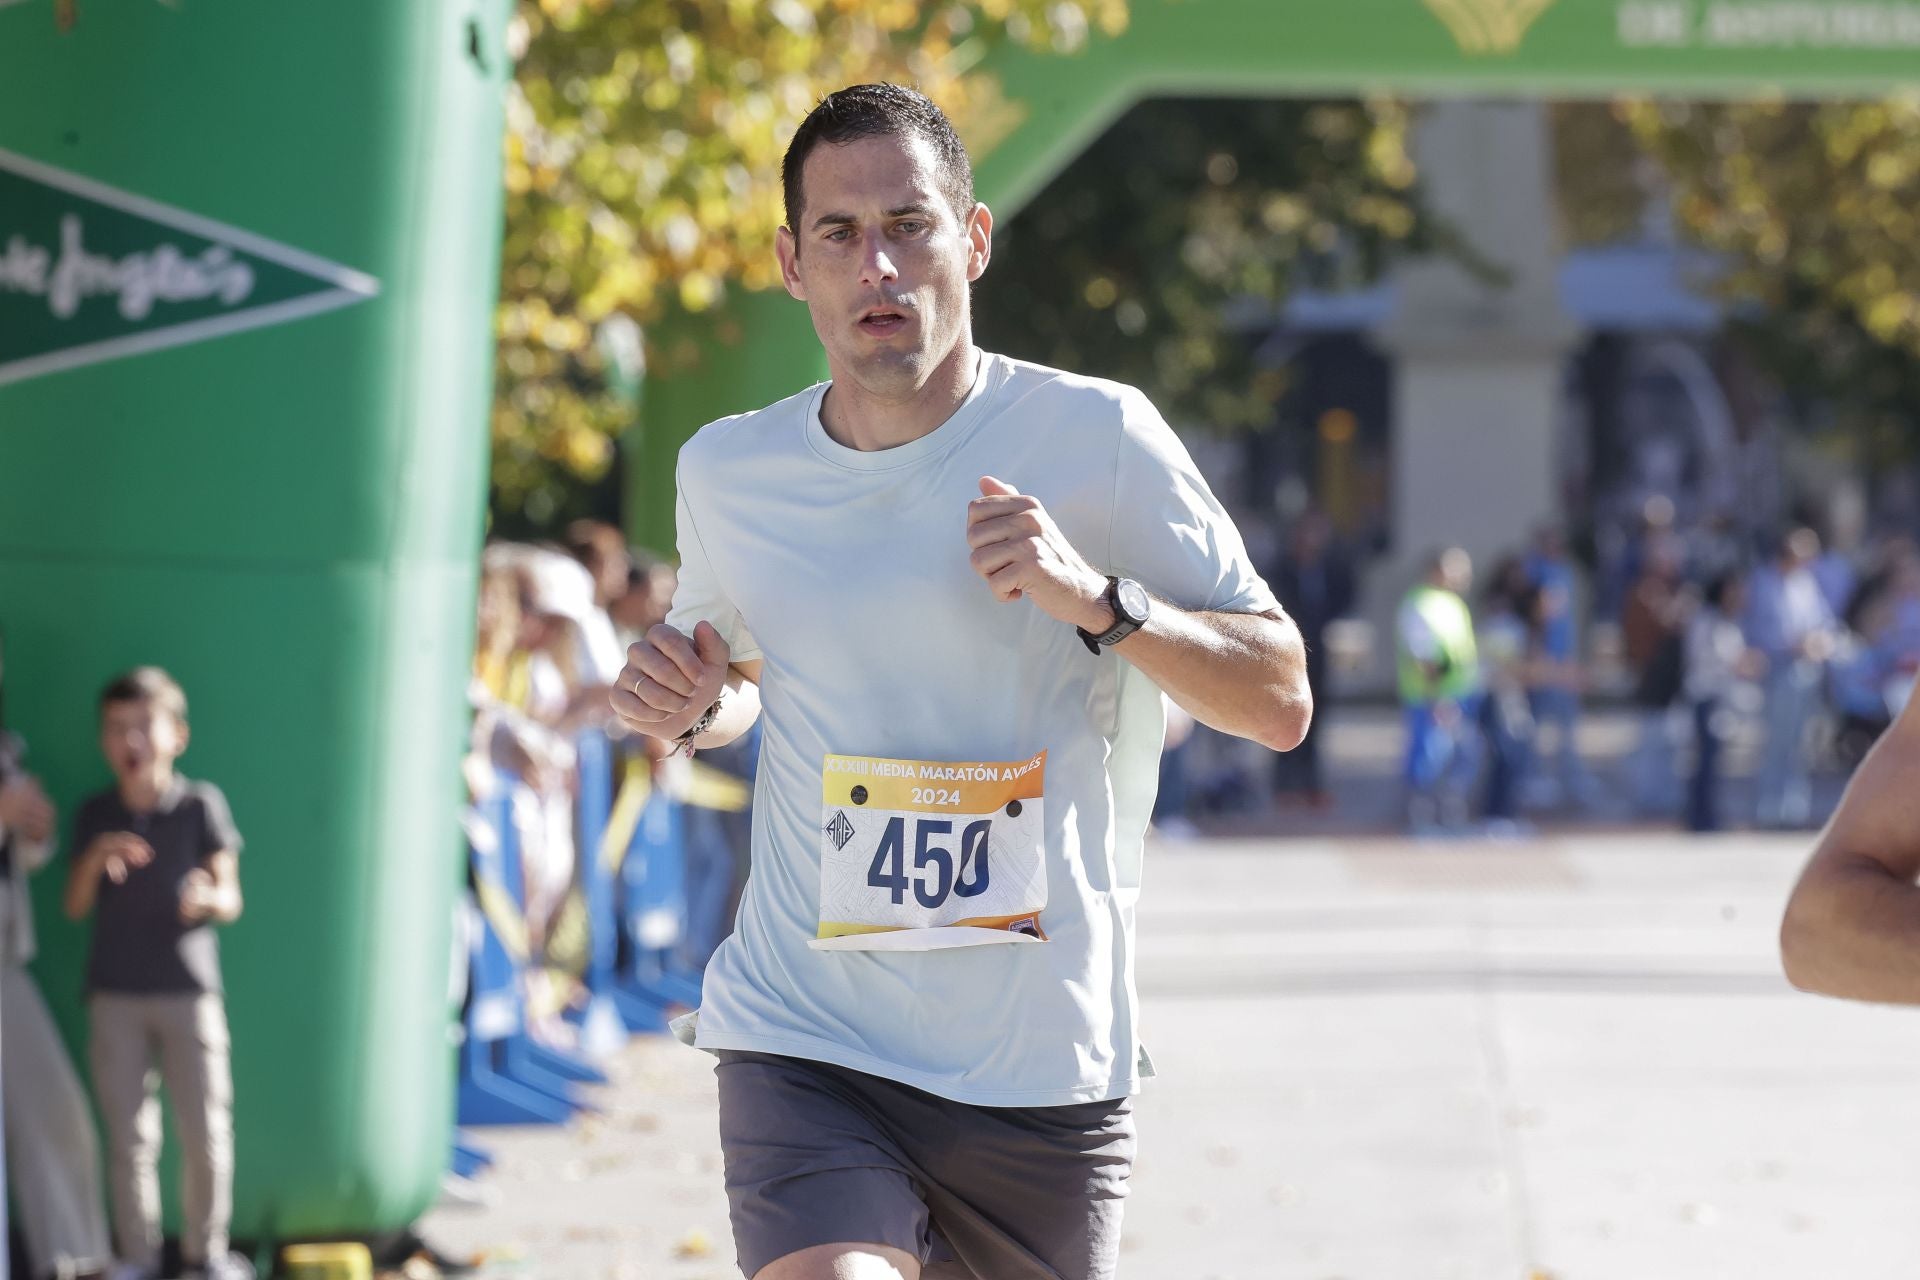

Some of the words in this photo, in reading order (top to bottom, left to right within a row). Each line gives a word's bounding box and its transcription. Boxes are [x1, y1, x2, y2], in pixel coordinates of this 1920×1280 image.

[827, 759, 868, 776] XXXIII
[872, 764, 916, 778] MEDIA
[920, 763, 998, 782] MARATÓN
[1001, 754, 1041, 781] AVILÉS
[911, 787, 961, 806] 2024
[867, 816, 992, 909] 450
